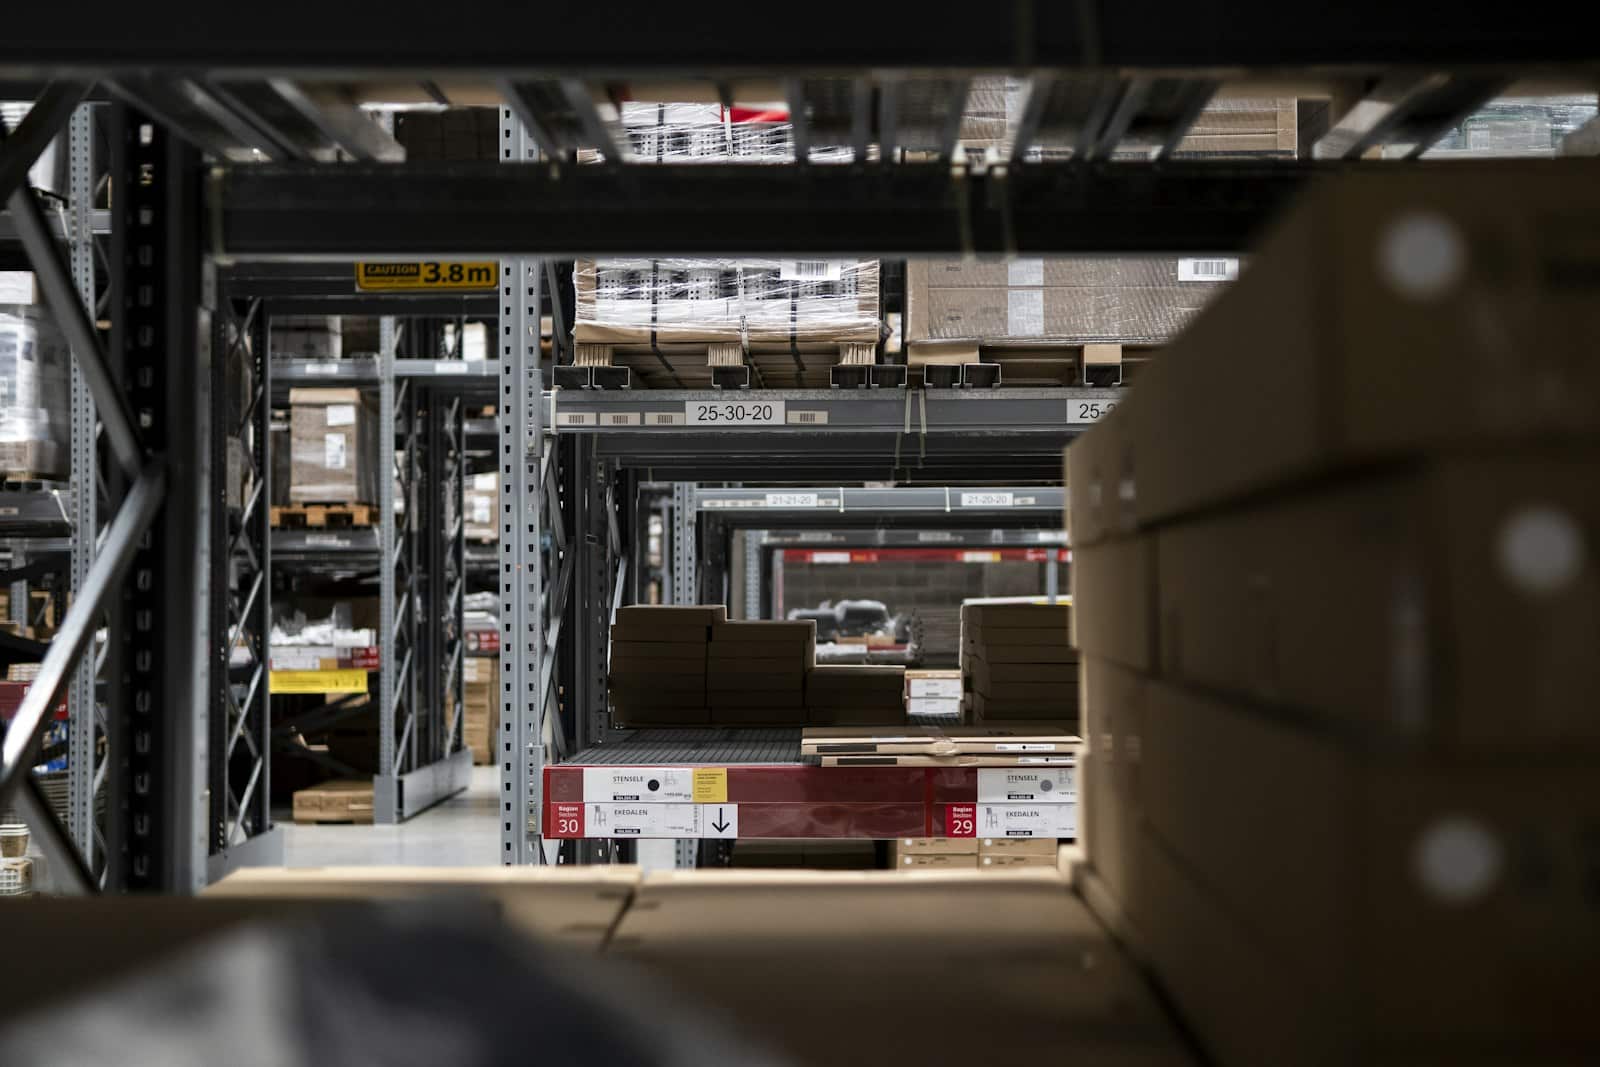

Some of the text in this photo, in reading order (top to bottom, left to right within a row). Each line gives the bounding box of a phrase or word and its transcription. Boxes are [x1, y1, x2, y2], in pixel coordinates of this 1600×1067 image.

[697, 405, 773, 421] 25-30-20
[613, 775, 644, 783] STENSELE
[558, 819, 579, 833] 30
[952, 820, 973, 834] 29
